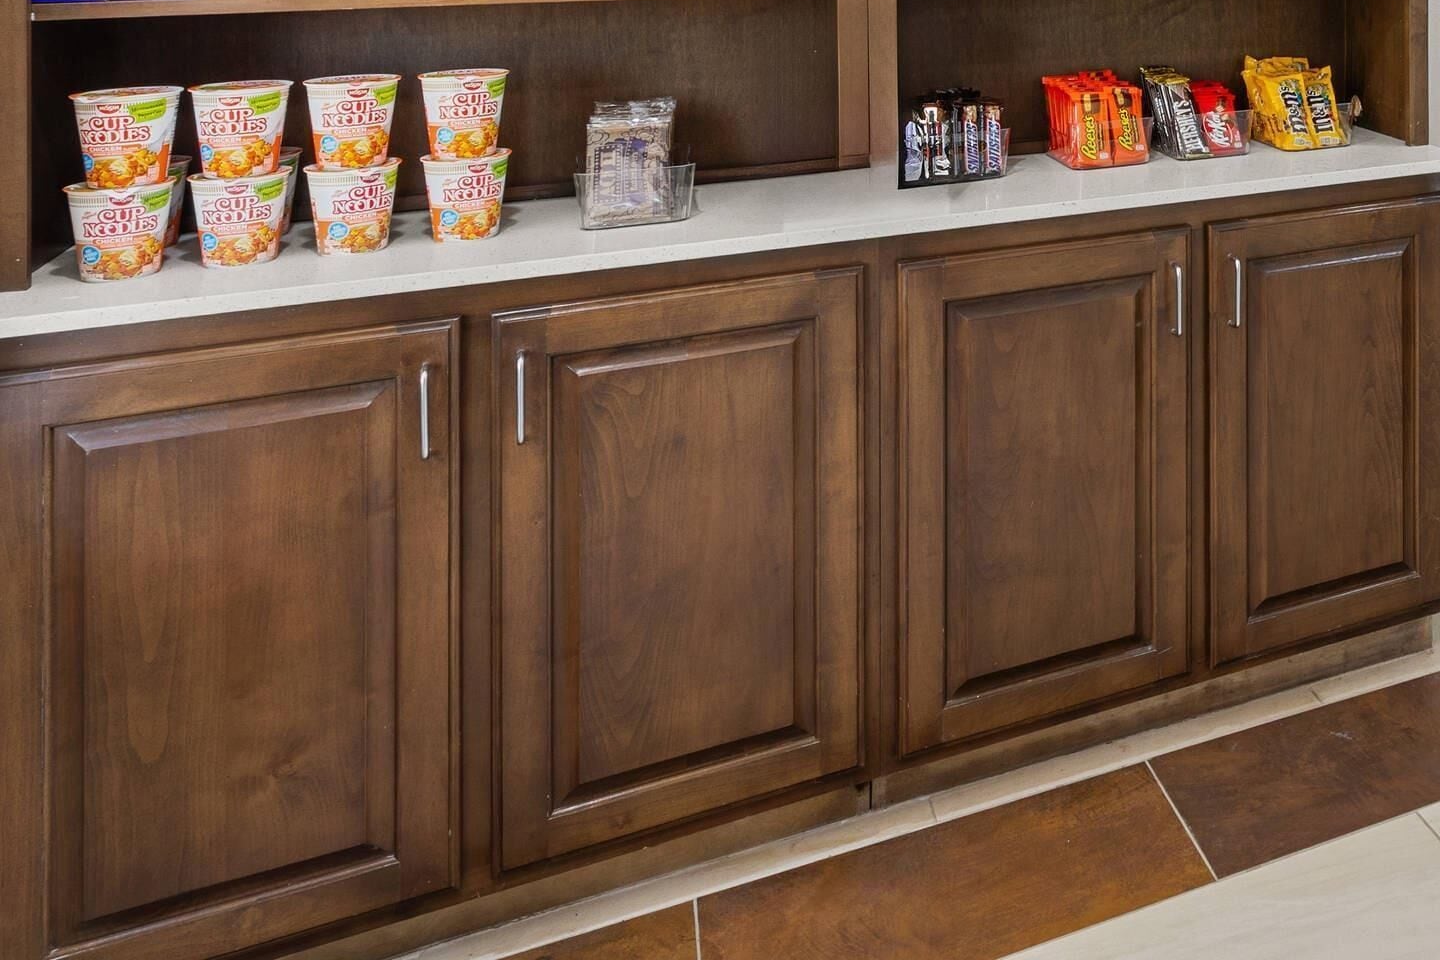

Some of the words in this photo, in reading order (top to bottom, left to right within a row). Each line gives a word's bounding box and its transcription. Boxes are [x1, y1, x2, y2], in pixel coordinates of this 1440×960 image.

[336, 99, 378, 114] CUP
[452, 91, 490, 106] CUP
[210, 108, 254, 123] CUP
[323, 109, 386, 127] NOODLES
[440, 102, 498, 119] NOODLES
[89, 116, 135, 131] CUP
[200, 117, 267, 136] NOODLES
[1174, 100, 1207, 152] HERSHEY'S
[80, 125, 151, 145] NOODLES
[966, 121, 979, 173] SNICKERS
[457, 174, 496, 188] CUP
[349, 183, 387, 199] CUP
[444, 184, 501, 202] NOODLES
[215, 195, 260, 211] CUP
[333, 192, 392, 215] NOODLES
[98, 206, 146, 223] CUP
[202, 204, 271, 225] NOODLES
[83, 214, 158, 238] NOODLES
